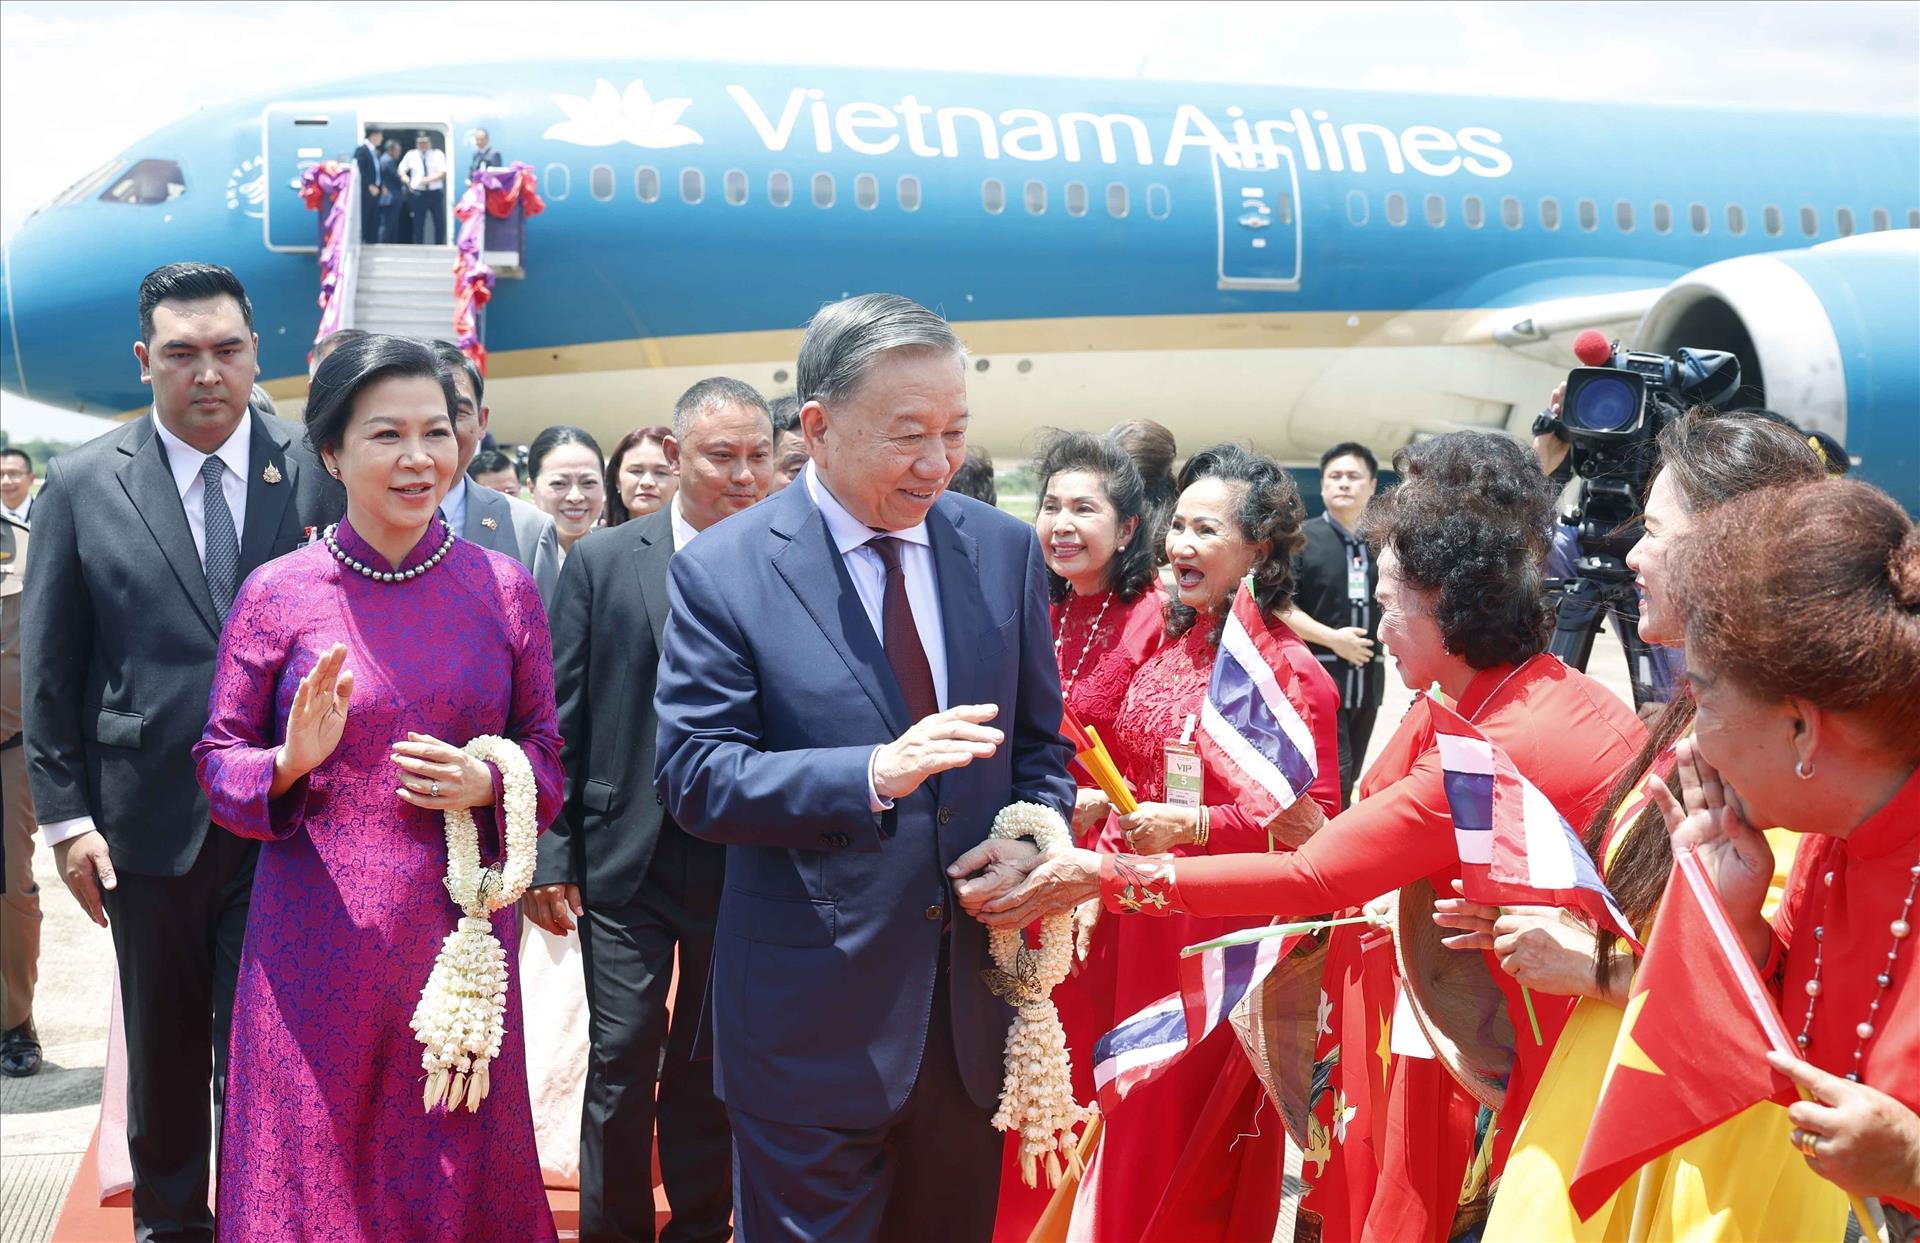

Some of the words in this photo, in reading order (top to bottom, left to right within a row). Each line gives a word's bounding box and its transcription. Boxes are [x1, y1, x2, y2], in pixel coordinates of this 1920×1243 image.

[726, 84, 1153, 165] Vietnam
[1164, 104, 1513, 178] Airlines
[1176, 762, 1193, 773] VIP
[1180, 775, 1188, 785] 5
